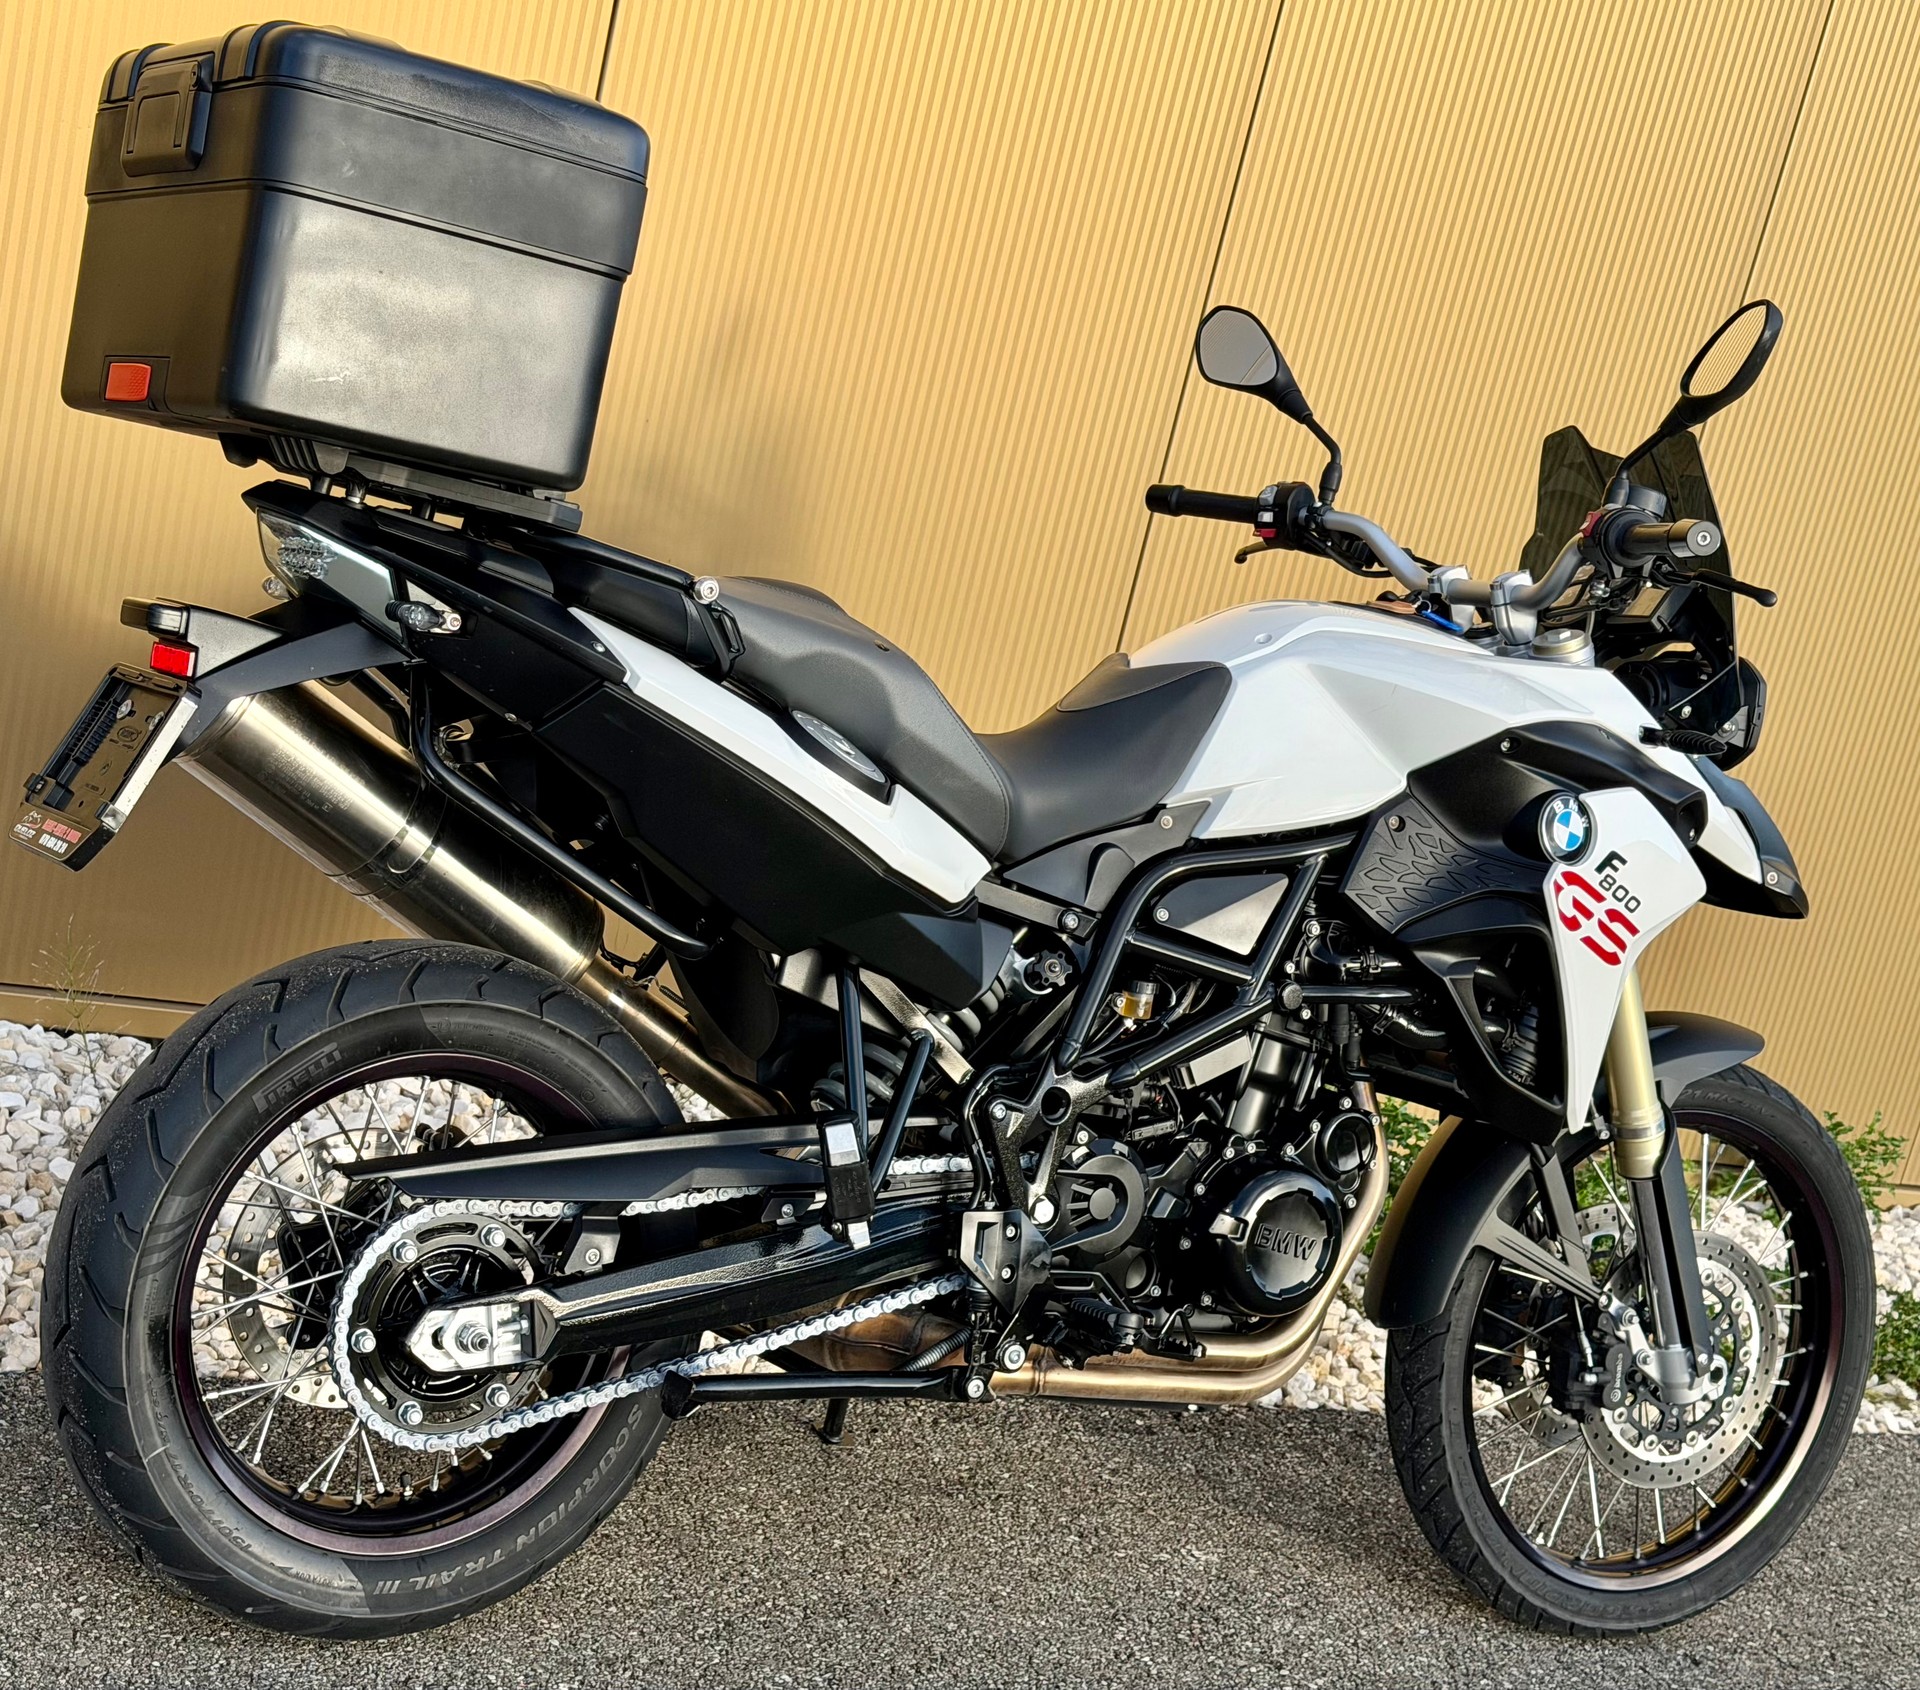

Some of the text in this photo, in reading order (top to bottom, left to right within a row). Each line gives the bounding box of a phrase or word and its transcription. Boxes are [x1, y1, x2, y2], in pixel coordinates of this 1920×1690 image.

[1553, 798, 1590, 828] BMW
[1593, 850, 1642, 914] F 800
[1552, 870, 1641, 967] GS
[251, 1041, 343, 1114] PIRELLI
[1254, 1222, 1318, 1261] BMW
[373, 1402, 644, 1596] SCORPION TRAIL III
